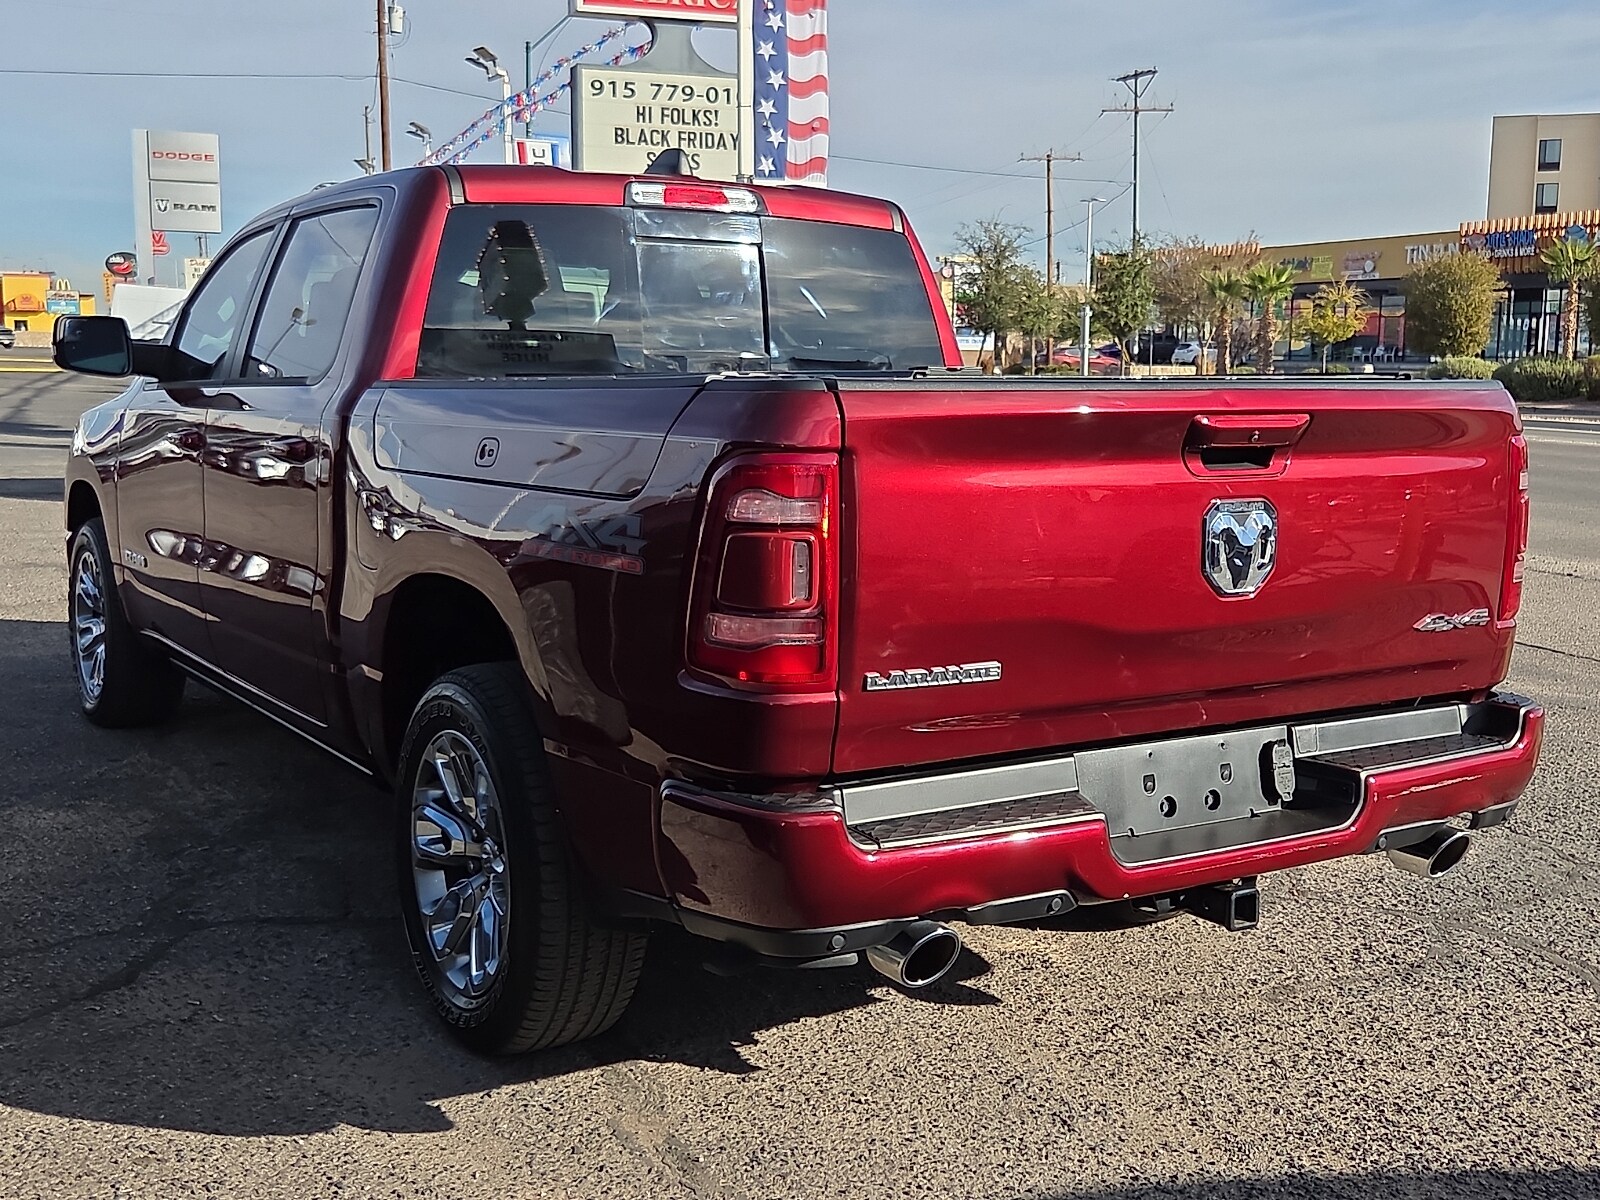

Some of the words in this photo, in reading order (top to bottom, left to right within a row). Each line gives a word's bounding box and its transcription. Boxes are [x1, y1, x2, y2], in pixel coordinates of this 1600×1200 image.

[590, 79, 637, 99] 915
[636, 105, 653, 125] HI
[661, 107, 720, 127] FOLKS!
[614, 127, 671, 148] BLACK
[678, 131, 739, 151] FRIDAY
[152, 151, 214, 161] DODGE
[173, 203, 217, 213] RAM
[864, 661, 1001, 691] LARAMIE
